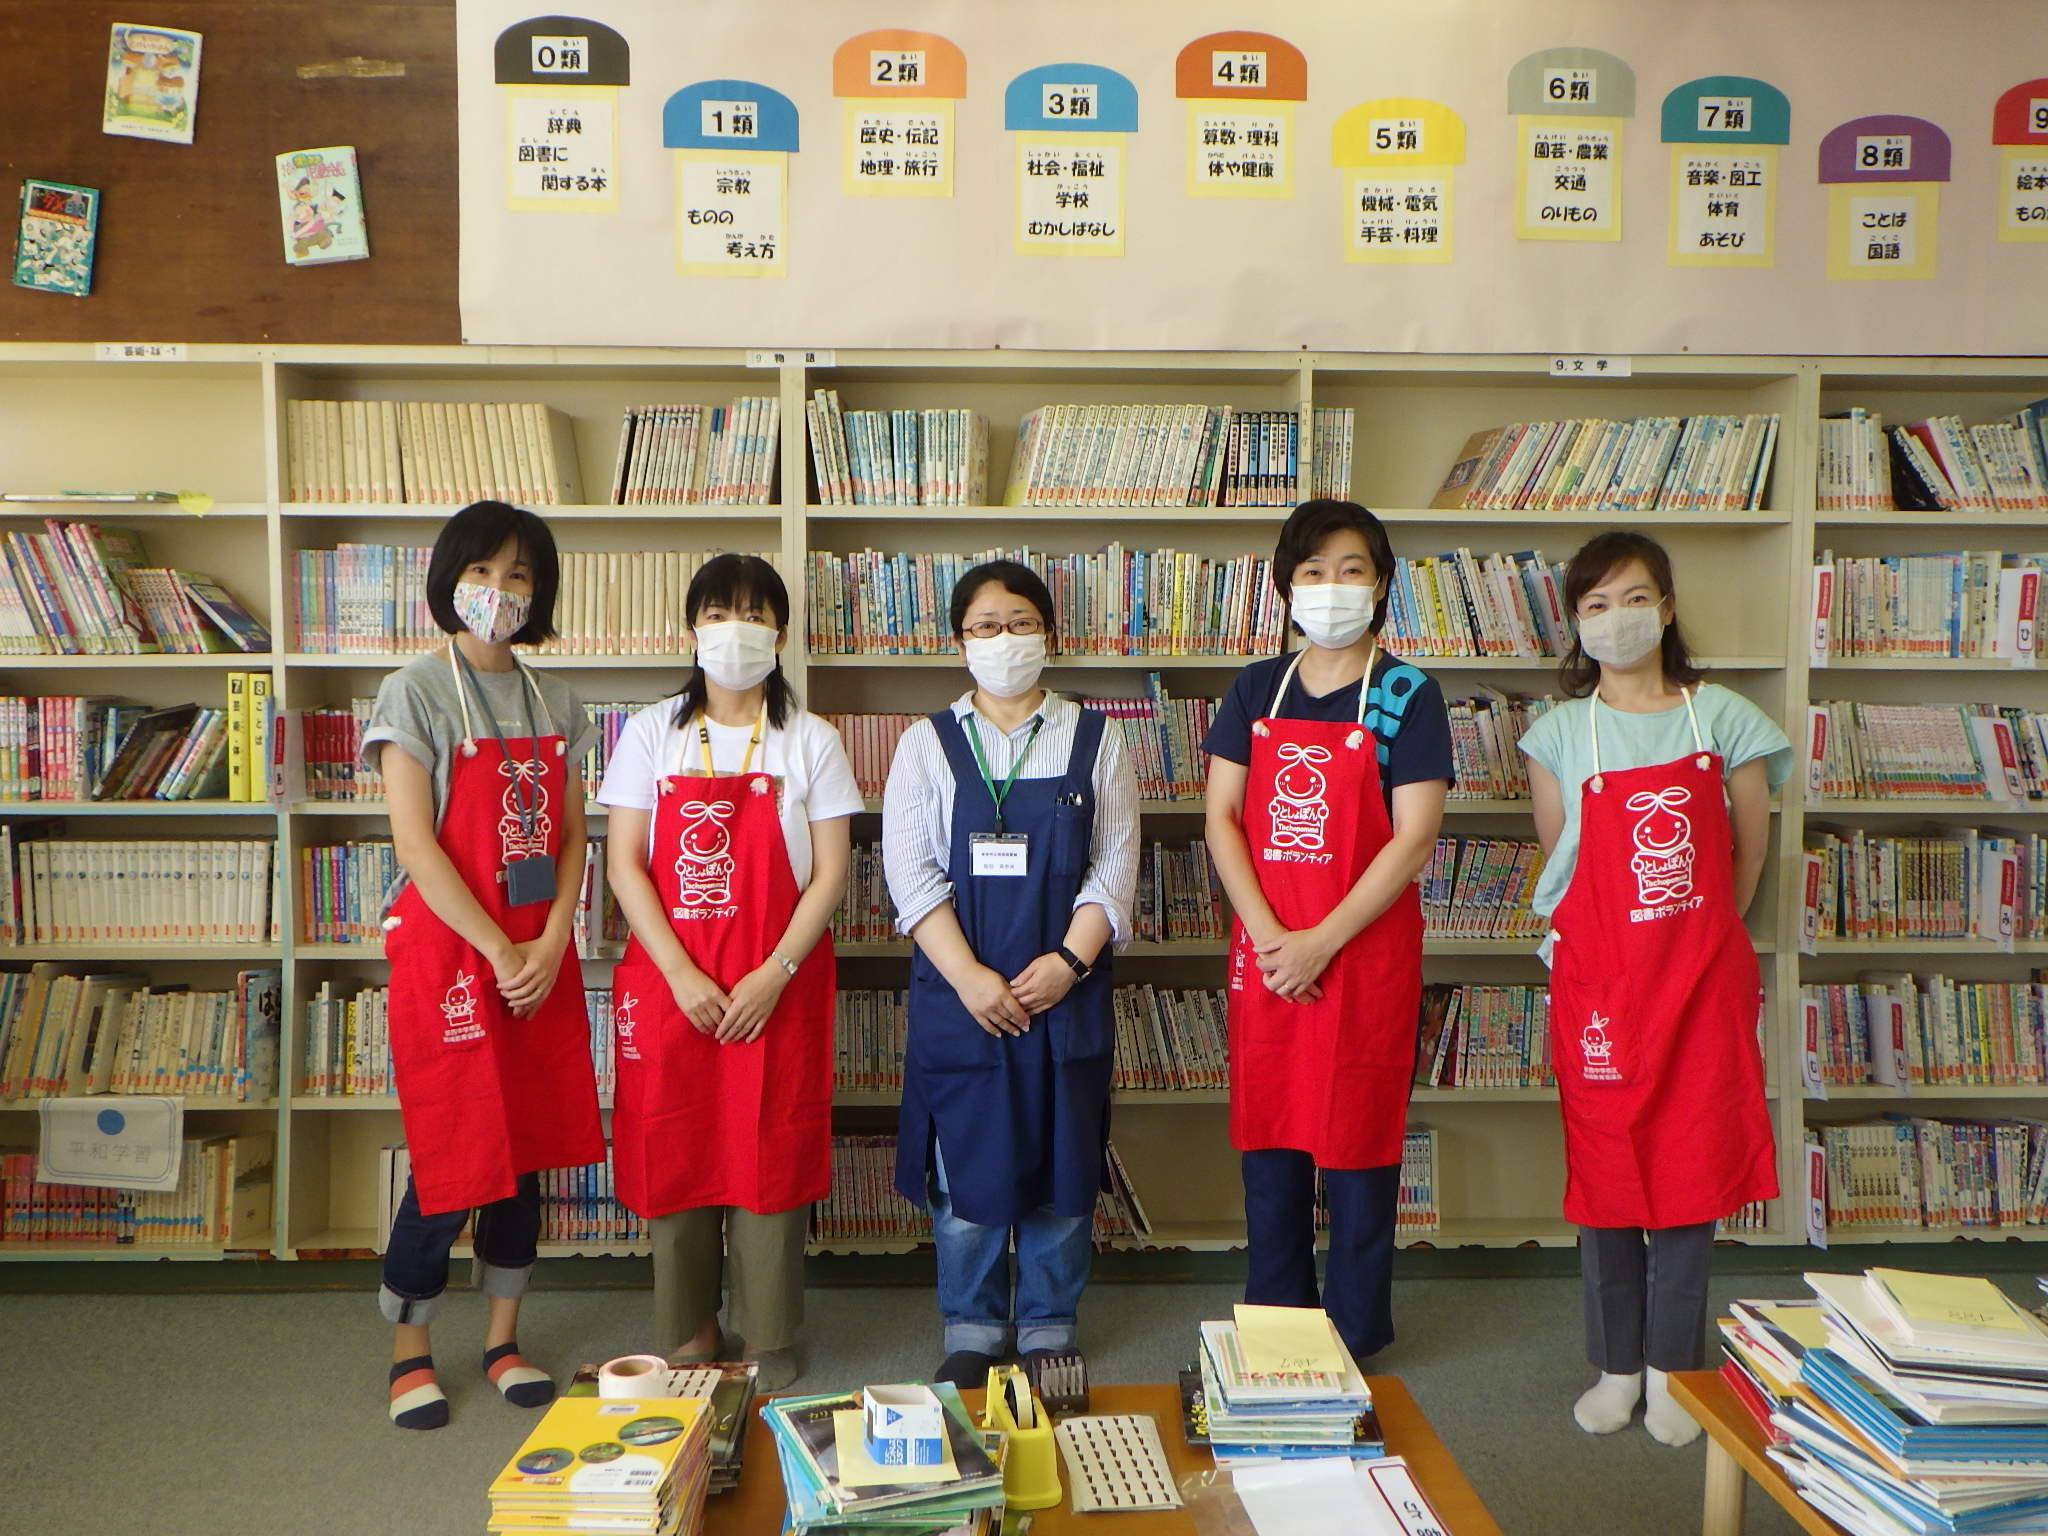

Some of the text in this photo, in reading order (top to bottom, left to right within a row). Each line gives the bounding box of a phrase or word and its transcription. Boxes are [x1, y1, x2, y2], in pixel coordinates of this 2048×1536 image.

[538, 46, 581, 69] 0類
[877, 59, 918, 82] 2類
[1217, 60, 1259, 83] 4類
[1549, 77, 1590, 101] 6類
[1048, 93, 1090, 116] 3類
[547, 117, 582, 134] 辞典
[712, 110, 753, 134] 1類
[1704, 105, 1744, 129] 7類
[860, 127, 939, 145] 歴史・伝記
[1202, 128, 1279, 147] 算数・理科
[1375, 127, 1417, 150] 5類
[518, 145, 569, 162] 図書に
[1534, 141, 1609, 160] 園芸・農業
[1862, 145, 1903, 167] 8類
[859, 159, 938, 176] 地理・旅行
[1027, 159, 1105, 177] 社会・福祉
[1208, 160, 1275, 178] 体や健康
[541, 174, 607, 192] 関する本
[716, 177, 751, 195] 宗教
[1554, 174, 1587, 191] 交通
[1687, 169, 1762, 186] 音楽・図工
[1055, 191, 1089, 208] 学校
[1361, 194, 1439, 212] 機械・電気
[1707, 200, 1740, 217] 体育
[687, 209, 734, 225] ものの
[1541, 206, 1598, 222] のりもの
[1862, 211, 1908, 228] ことば
[2015, 206, 2048, 221] もの
[1028, 221, 1116, 237] むかしばなし
[1360, 226, 1438, 243] 手芸・料理
[1699, 231, 1745, 248] あそび
[726, 241, 776, 259] 考え方
[1867, 242, 1901, 260] 国語
